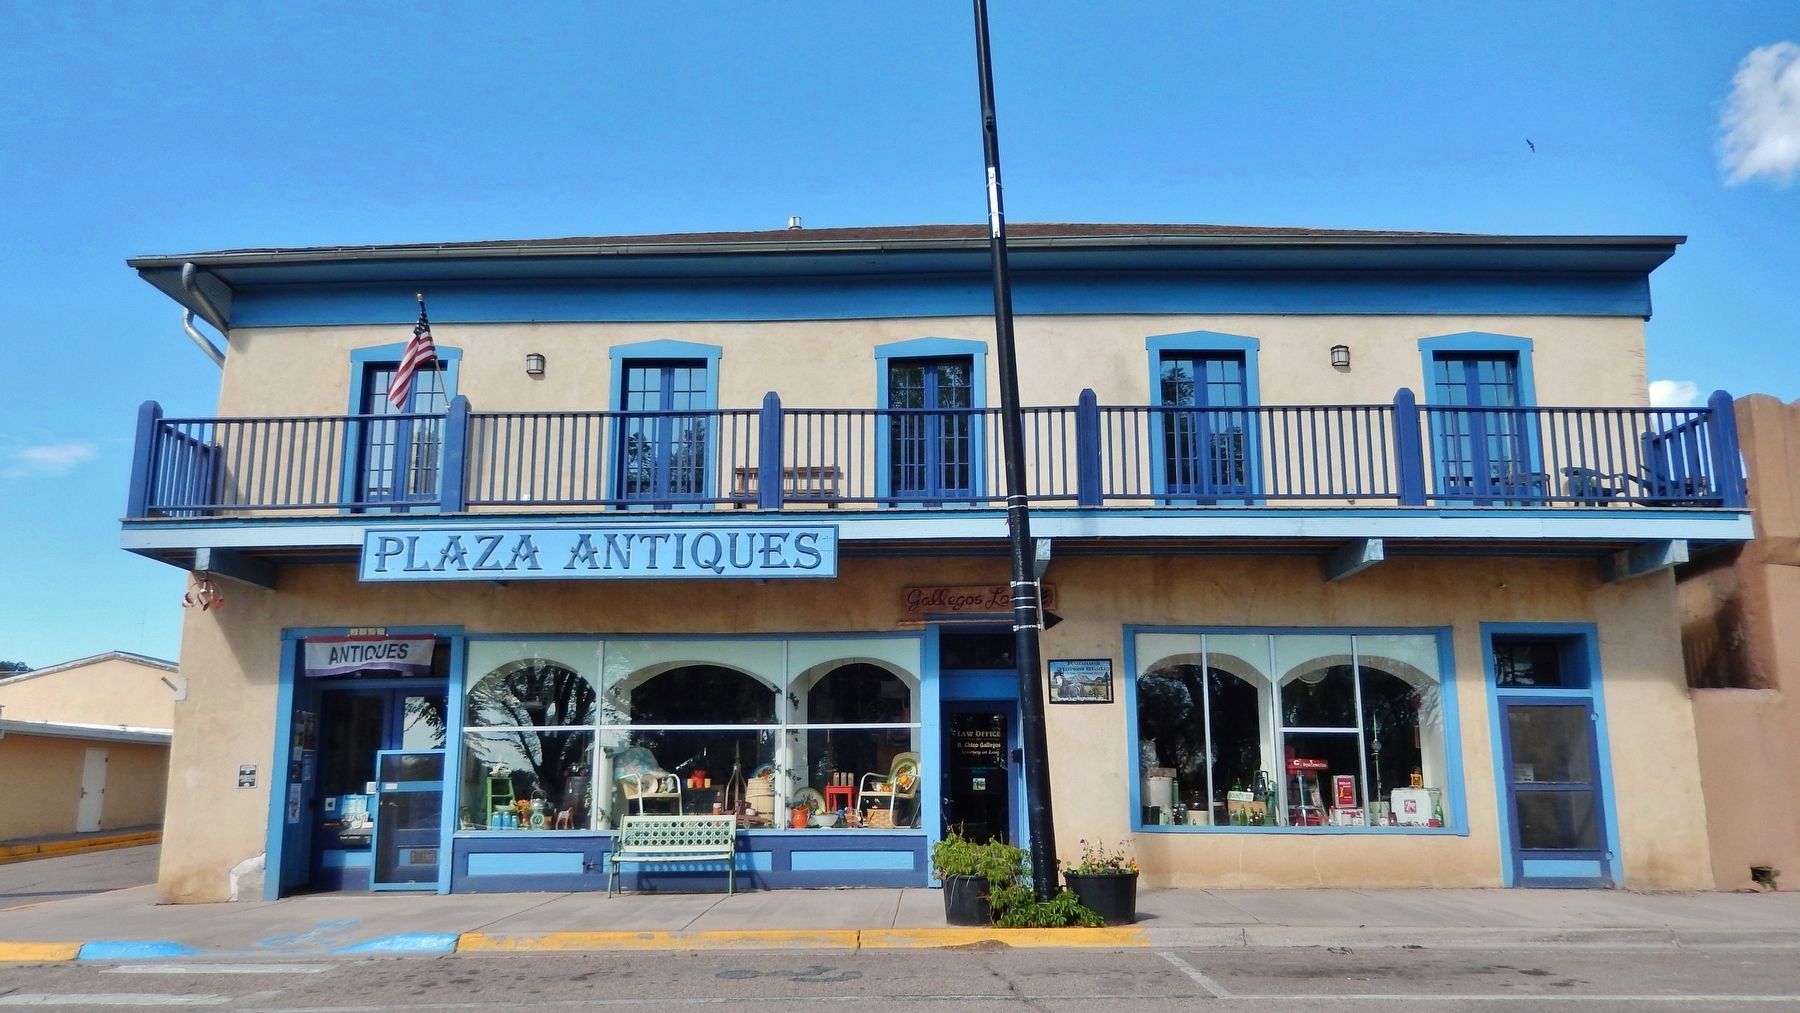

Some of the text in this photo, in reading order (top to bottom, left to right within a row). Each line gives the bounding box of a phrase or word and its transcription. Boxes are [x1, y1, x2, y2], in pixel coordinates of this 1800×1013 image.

[374, 530, 823, 575] PLAZA ANTIQUES
[907, 588, 983, 611] Gallegos
[328, 643, 410, 665] ANTIQUES
[957, 730, 1001, 738] LAW OFFICE
